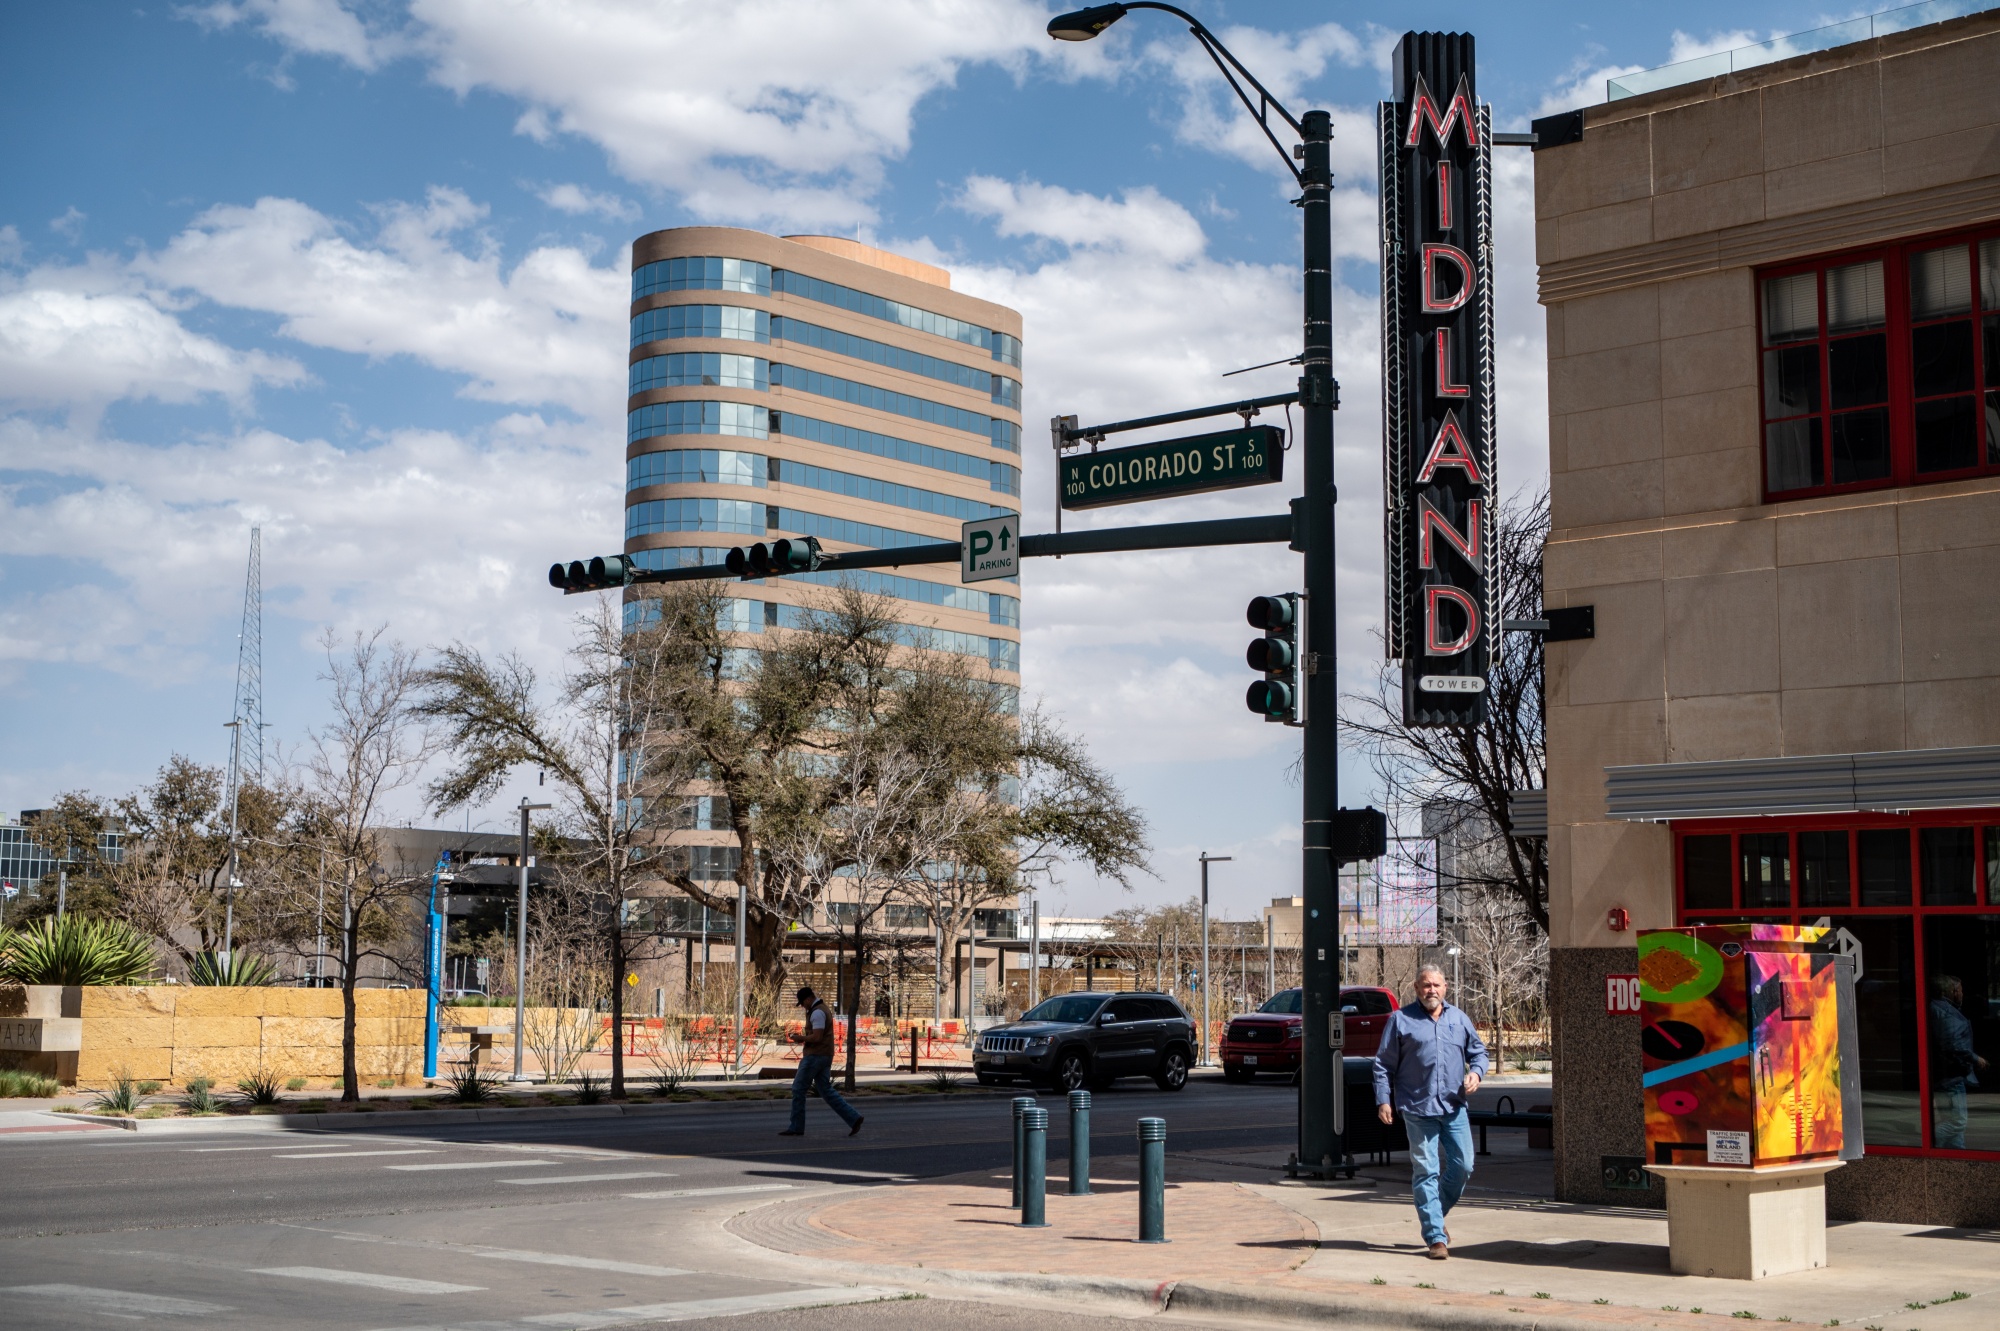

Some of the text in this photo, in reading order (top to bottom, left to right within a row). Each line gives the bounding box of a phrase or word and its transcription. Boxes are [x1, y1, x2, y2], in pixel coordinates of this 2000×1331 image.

[1404, 71, 1484, 656] MIDLAND
[1248, 439, 1255, 452] S
[1089, 444, 1236, 489] COLORADO ST
[1241, 453, 1263, 469] 100
[1071, 467, 1079, 480] N
[1066, 481, 1086, 496] 100
[1427, 679, 1479, 690] TOWER
[1607, 977, 1641, 1012] FDC
[0, 1023, 38, 1045] ARK
